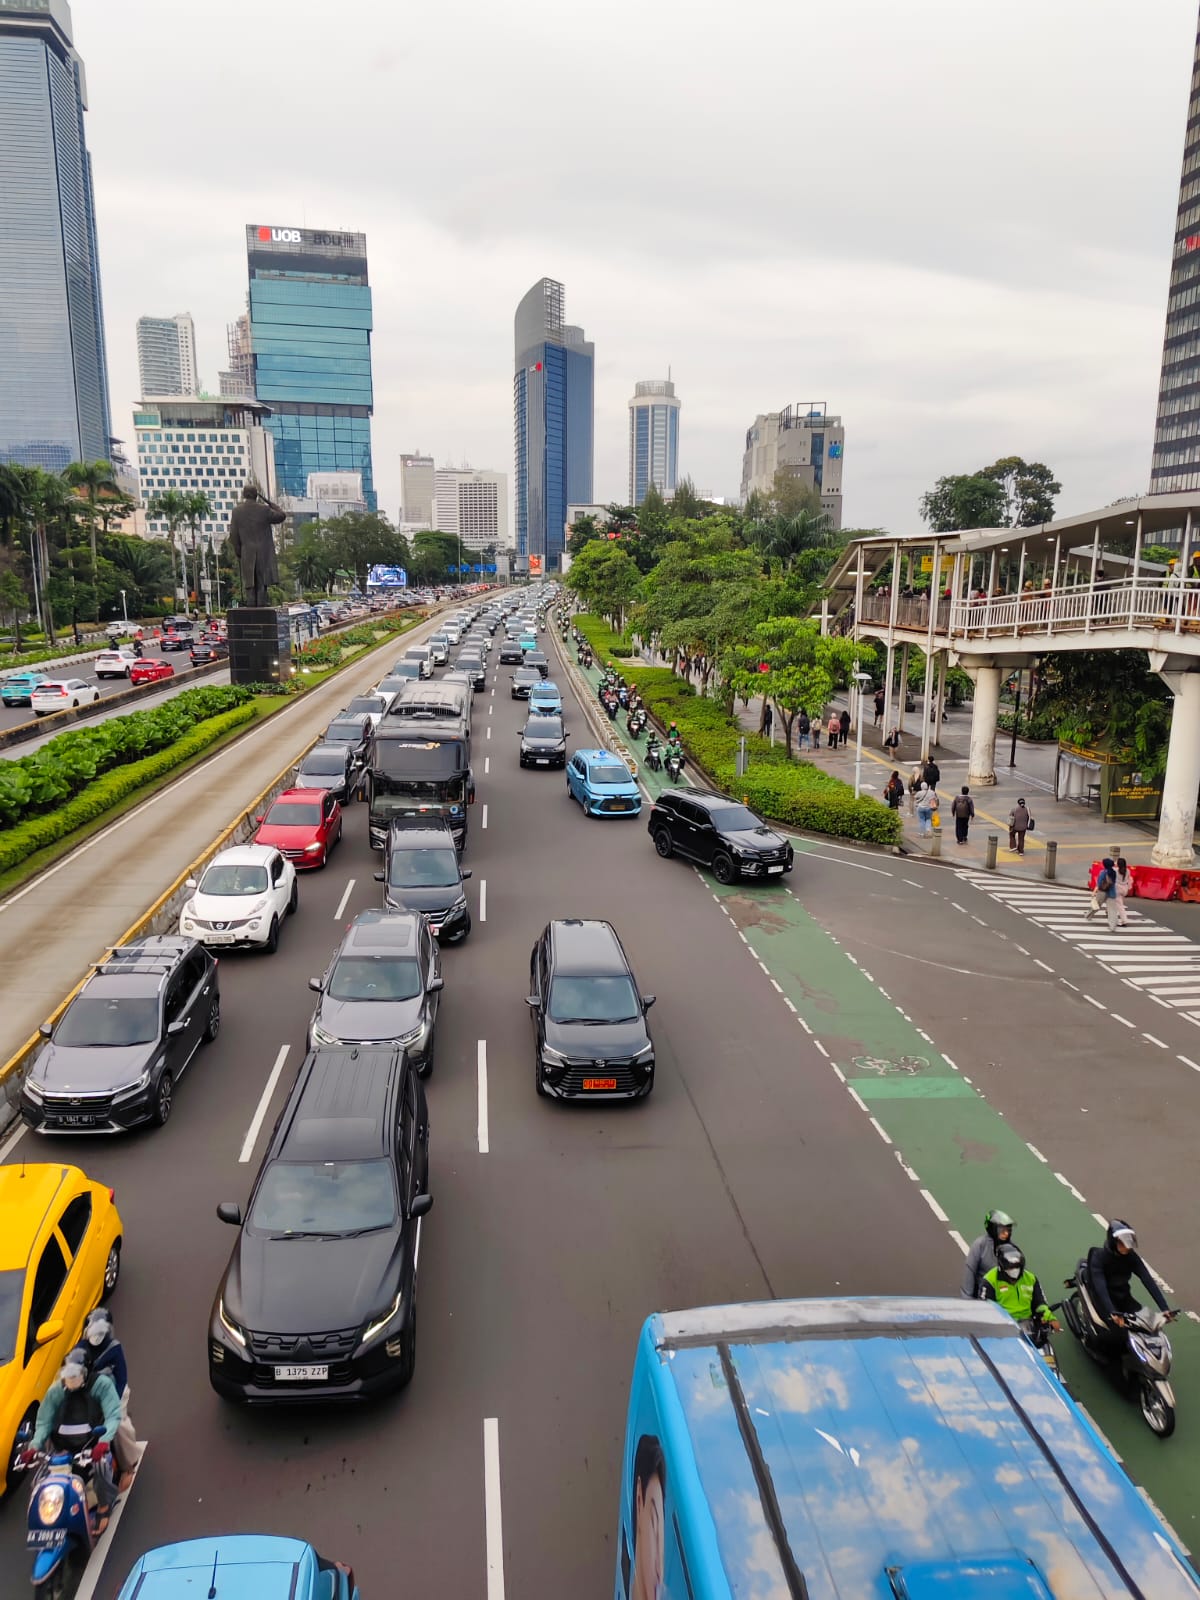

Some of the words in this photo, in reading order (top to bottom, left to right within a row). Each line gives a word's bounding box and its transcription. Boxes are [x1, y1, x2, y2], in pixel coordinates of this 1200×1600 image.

[272, 229, 302, 243] UOB
[275, 1368, 281, 1376] B
[287, 1368, 308, 1376] 1375
[311, 1367, 328, 1376] ZZP
